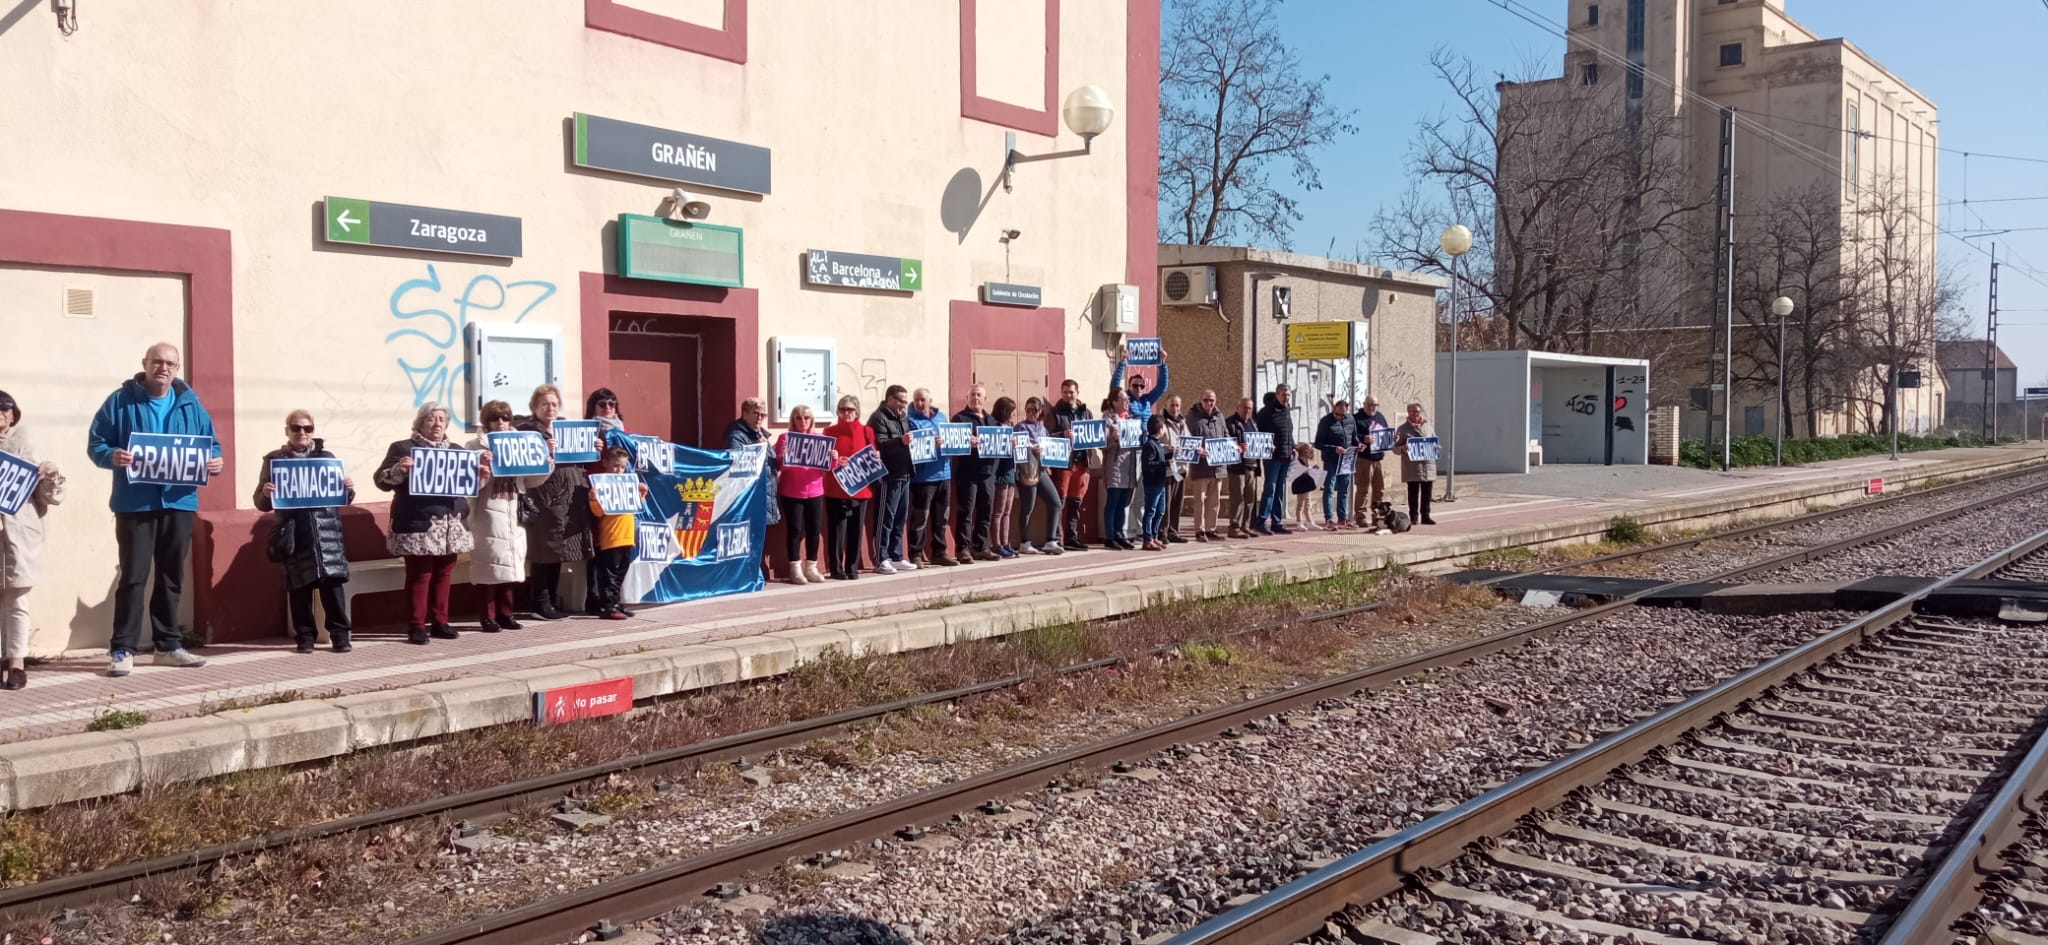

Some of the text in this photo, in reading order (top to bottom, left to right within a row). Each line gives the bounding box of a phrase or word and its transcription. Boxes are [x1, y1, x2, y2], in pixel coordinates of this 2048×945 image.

[652, 142, 716, 172] GRAÑÉN
[410, 218, 487, 244] Zaragoza
[832, 261, 881, 279] Barcelona
[1128, 342, 1159, 361] ROBRES
[1072, 423, 1106, 444] FRULA
[129, 438, 210, 482] GRAÑÉN
[493, 436, 545, 467] TORRES
[786, 438, 832, 467] VALFONDA
[272, 465, 344, 498] TRAMACED
[411, 450, 476, 494] ROBRES
[589, 693, 618, 708] pasar
